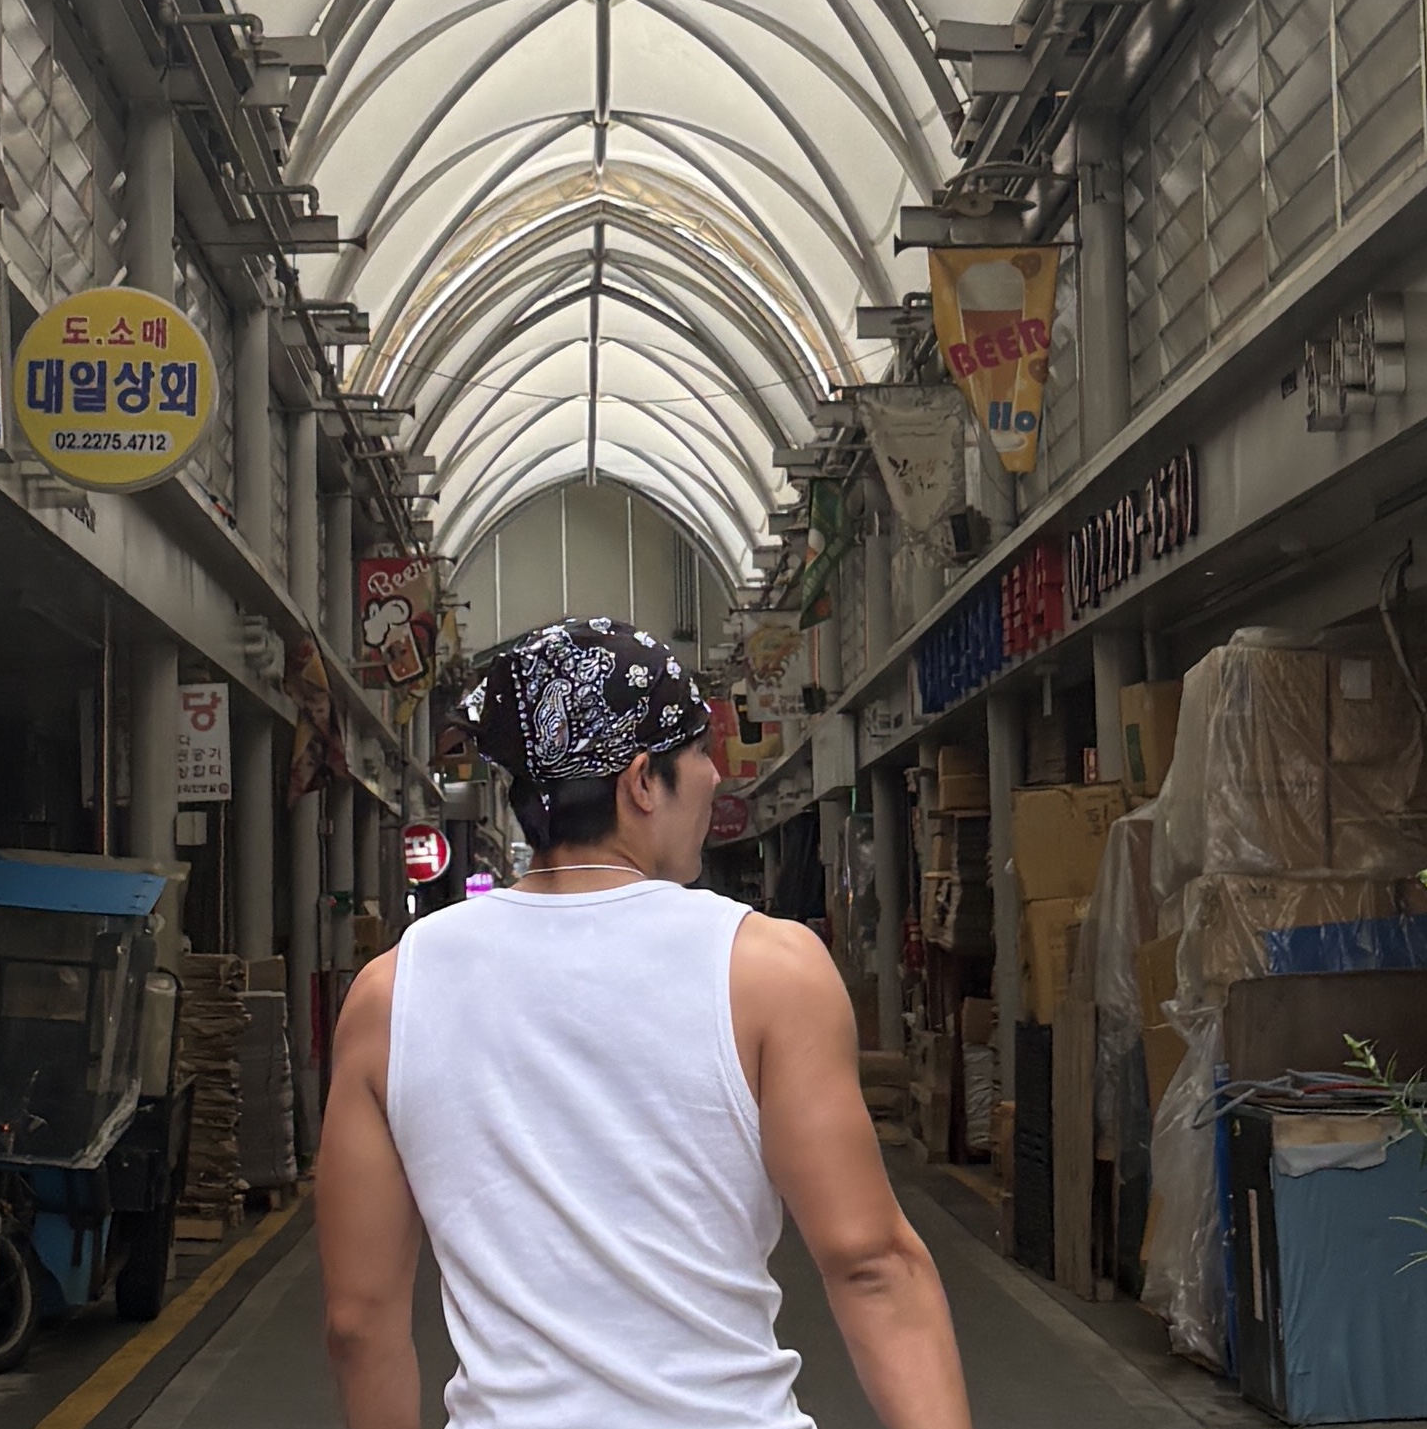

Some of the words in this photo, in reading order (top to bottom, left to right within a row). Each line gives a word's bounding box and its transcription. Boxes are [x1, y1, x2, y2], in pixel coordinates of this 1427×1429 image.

[61, 316, 168, 350] 도.소매
[948, 318, 1051, 379] BEER
[26, 358, 198, 417] 대일상회
[54, 431, 167, 452] 02.2275.4712
[367, 558, 432, 597] Beer
